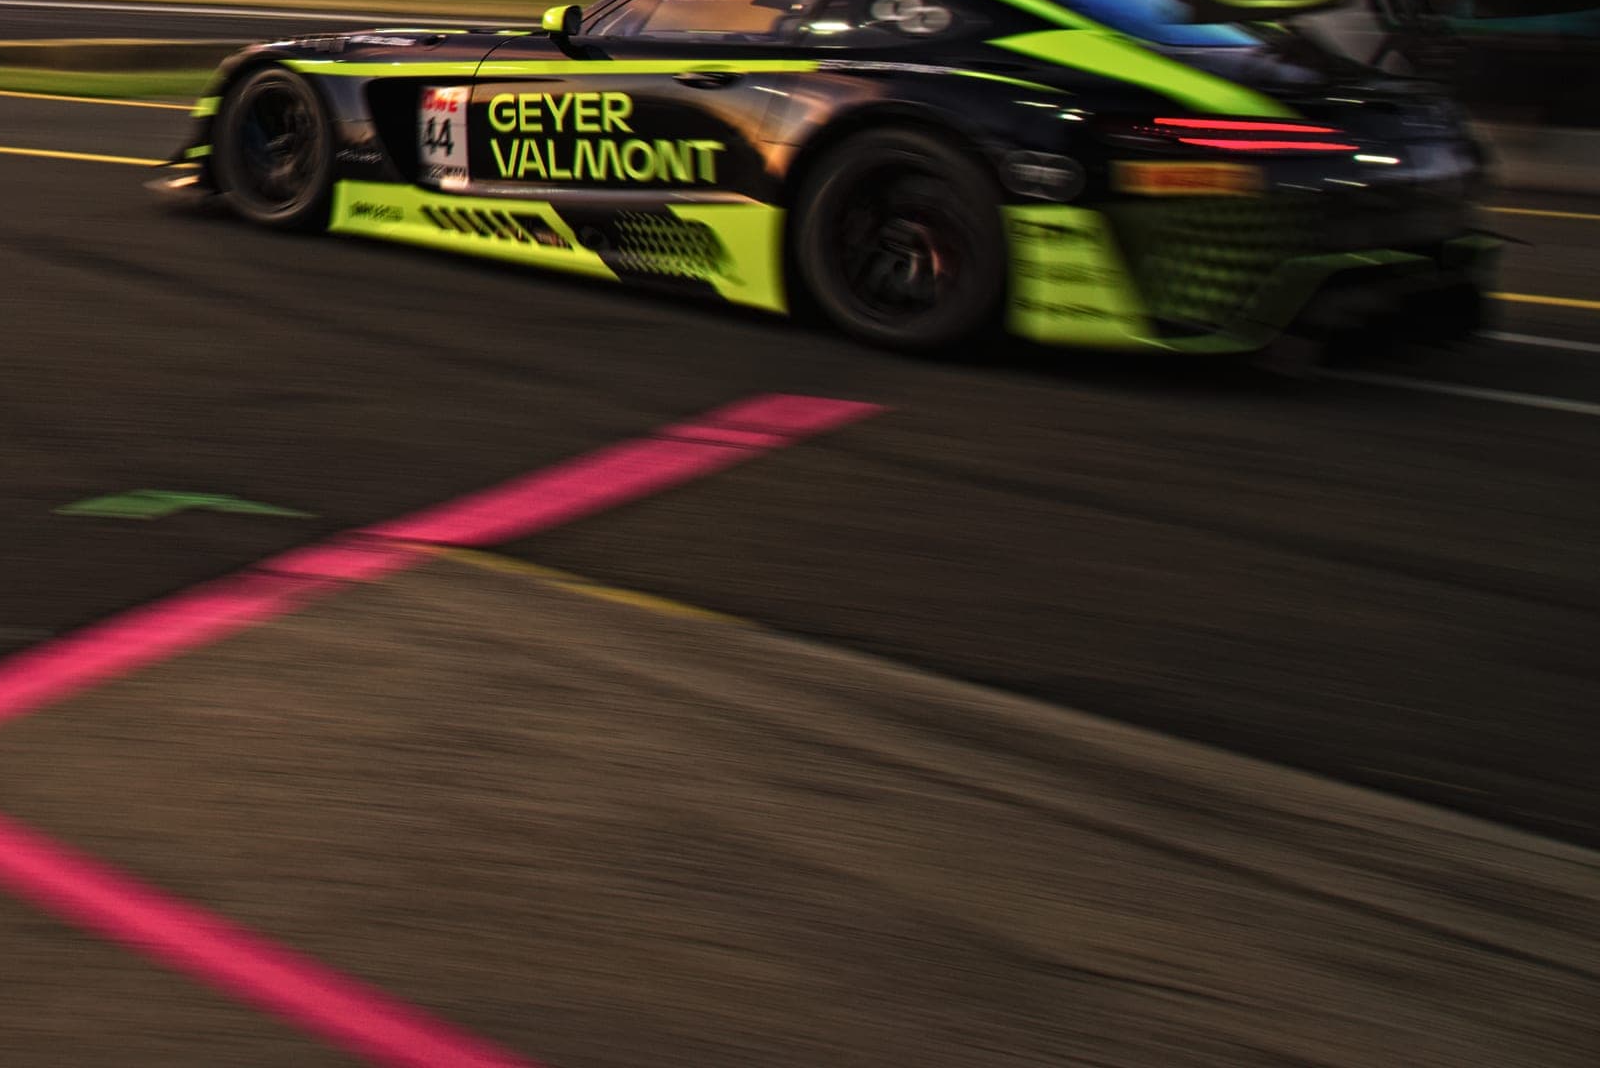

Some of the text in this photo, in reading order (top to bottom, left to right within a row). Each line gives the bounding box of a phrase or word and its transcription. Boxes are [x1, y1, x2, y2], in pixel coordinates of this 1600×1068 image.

[488, 92, 634, 133] GEYER
[422, 116, 454, 157] 44
[490, 138, 727, 183] VALMONT
